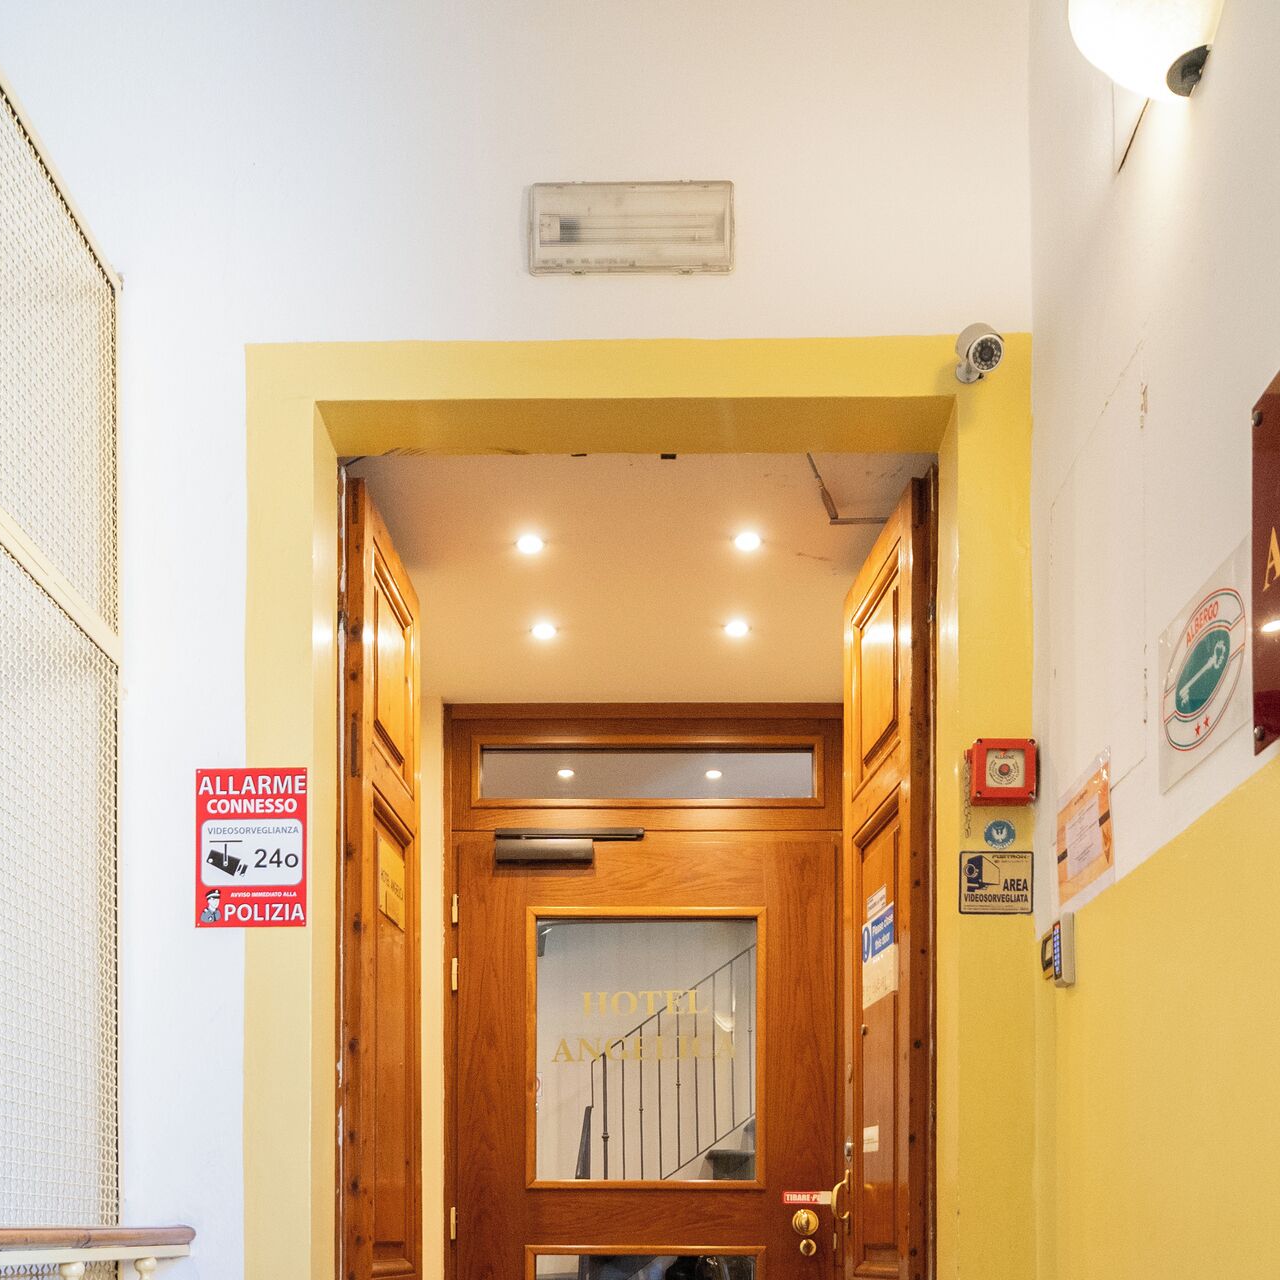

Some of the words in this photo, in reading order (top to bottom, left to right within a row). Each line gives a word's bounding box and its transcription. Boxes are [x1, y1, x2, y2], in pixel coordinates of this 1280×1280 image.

[1186, 601, 1219, 646] ALBERGO
[198, 775, 307, 796] ALLARME
[206, 798, 298, 814] CONNESSO
[207, 826, 299, 835] VIDEOSORVEGLIANZA
[1002, 878, 1029, 892] AREA
[963, 893, 1029, 903] VIDEOSORVEGLIATA
[223, 903, 305, 922] POLIZIA
[582, 989, 710, 1019] HOTEL
[551, 1034, 737, 1063] ANGELICA
